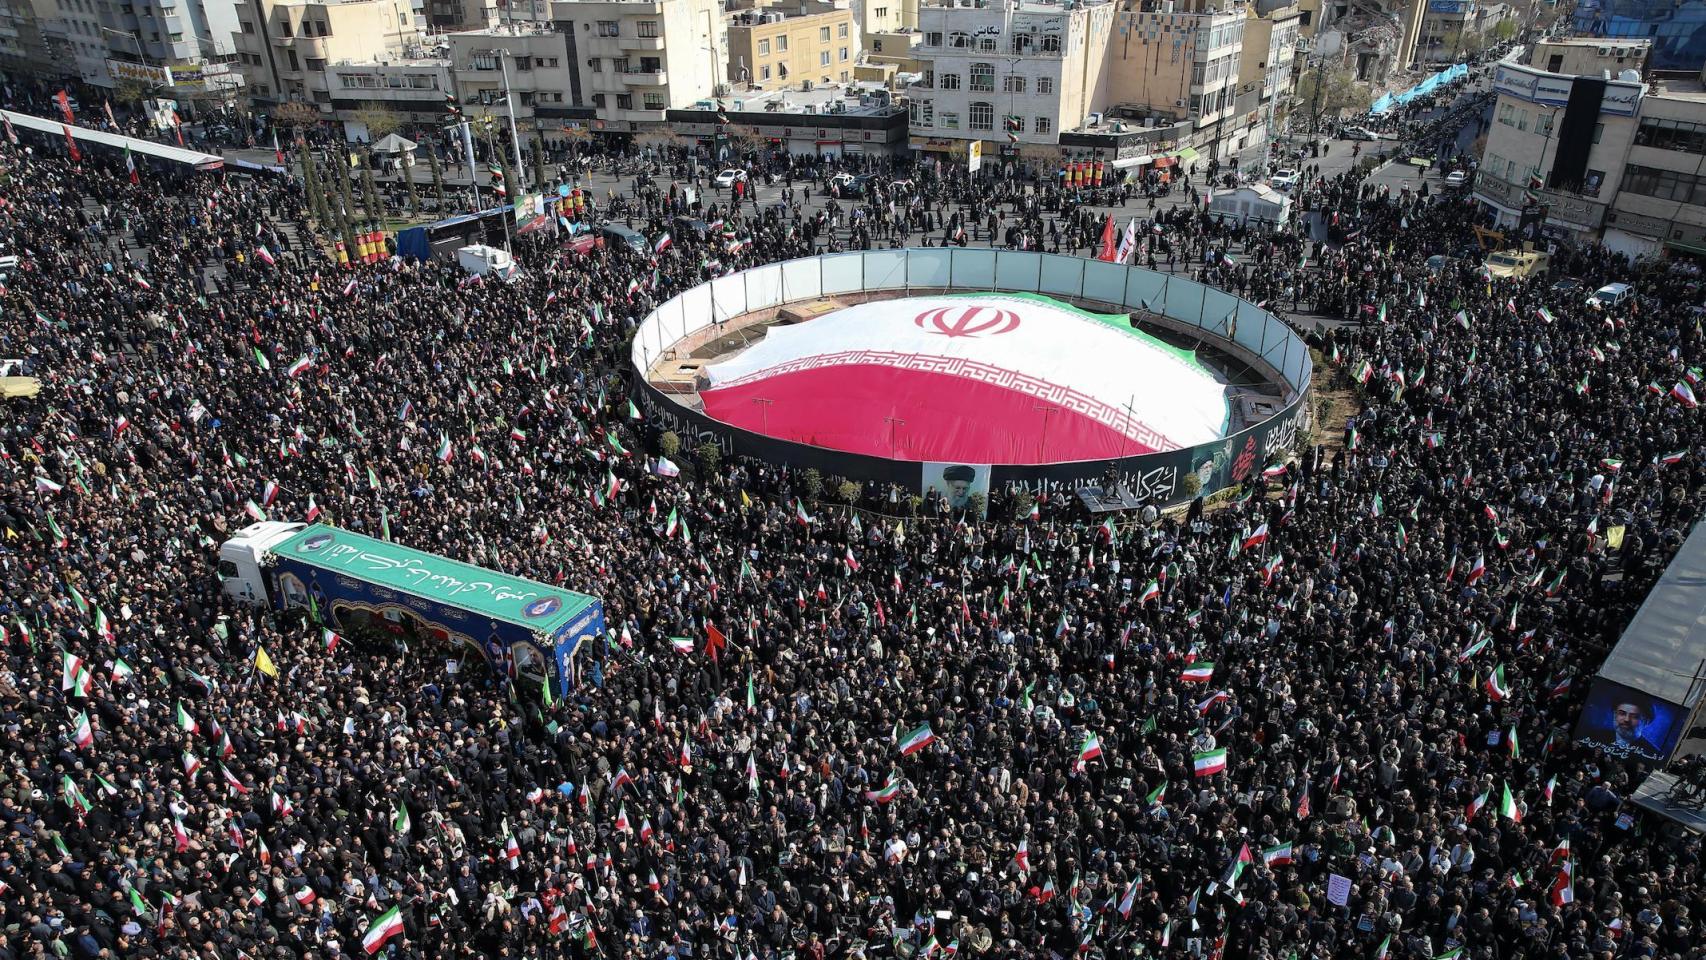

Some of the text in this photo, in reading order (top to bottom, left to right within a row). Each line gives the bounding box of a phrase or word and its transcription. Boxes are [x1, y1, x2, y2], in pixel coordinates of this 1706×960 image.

[319, 543, 356, 561] الله
[345, 550, 424, 570] اکبر
[488, 586, 537, 602] رهبر
